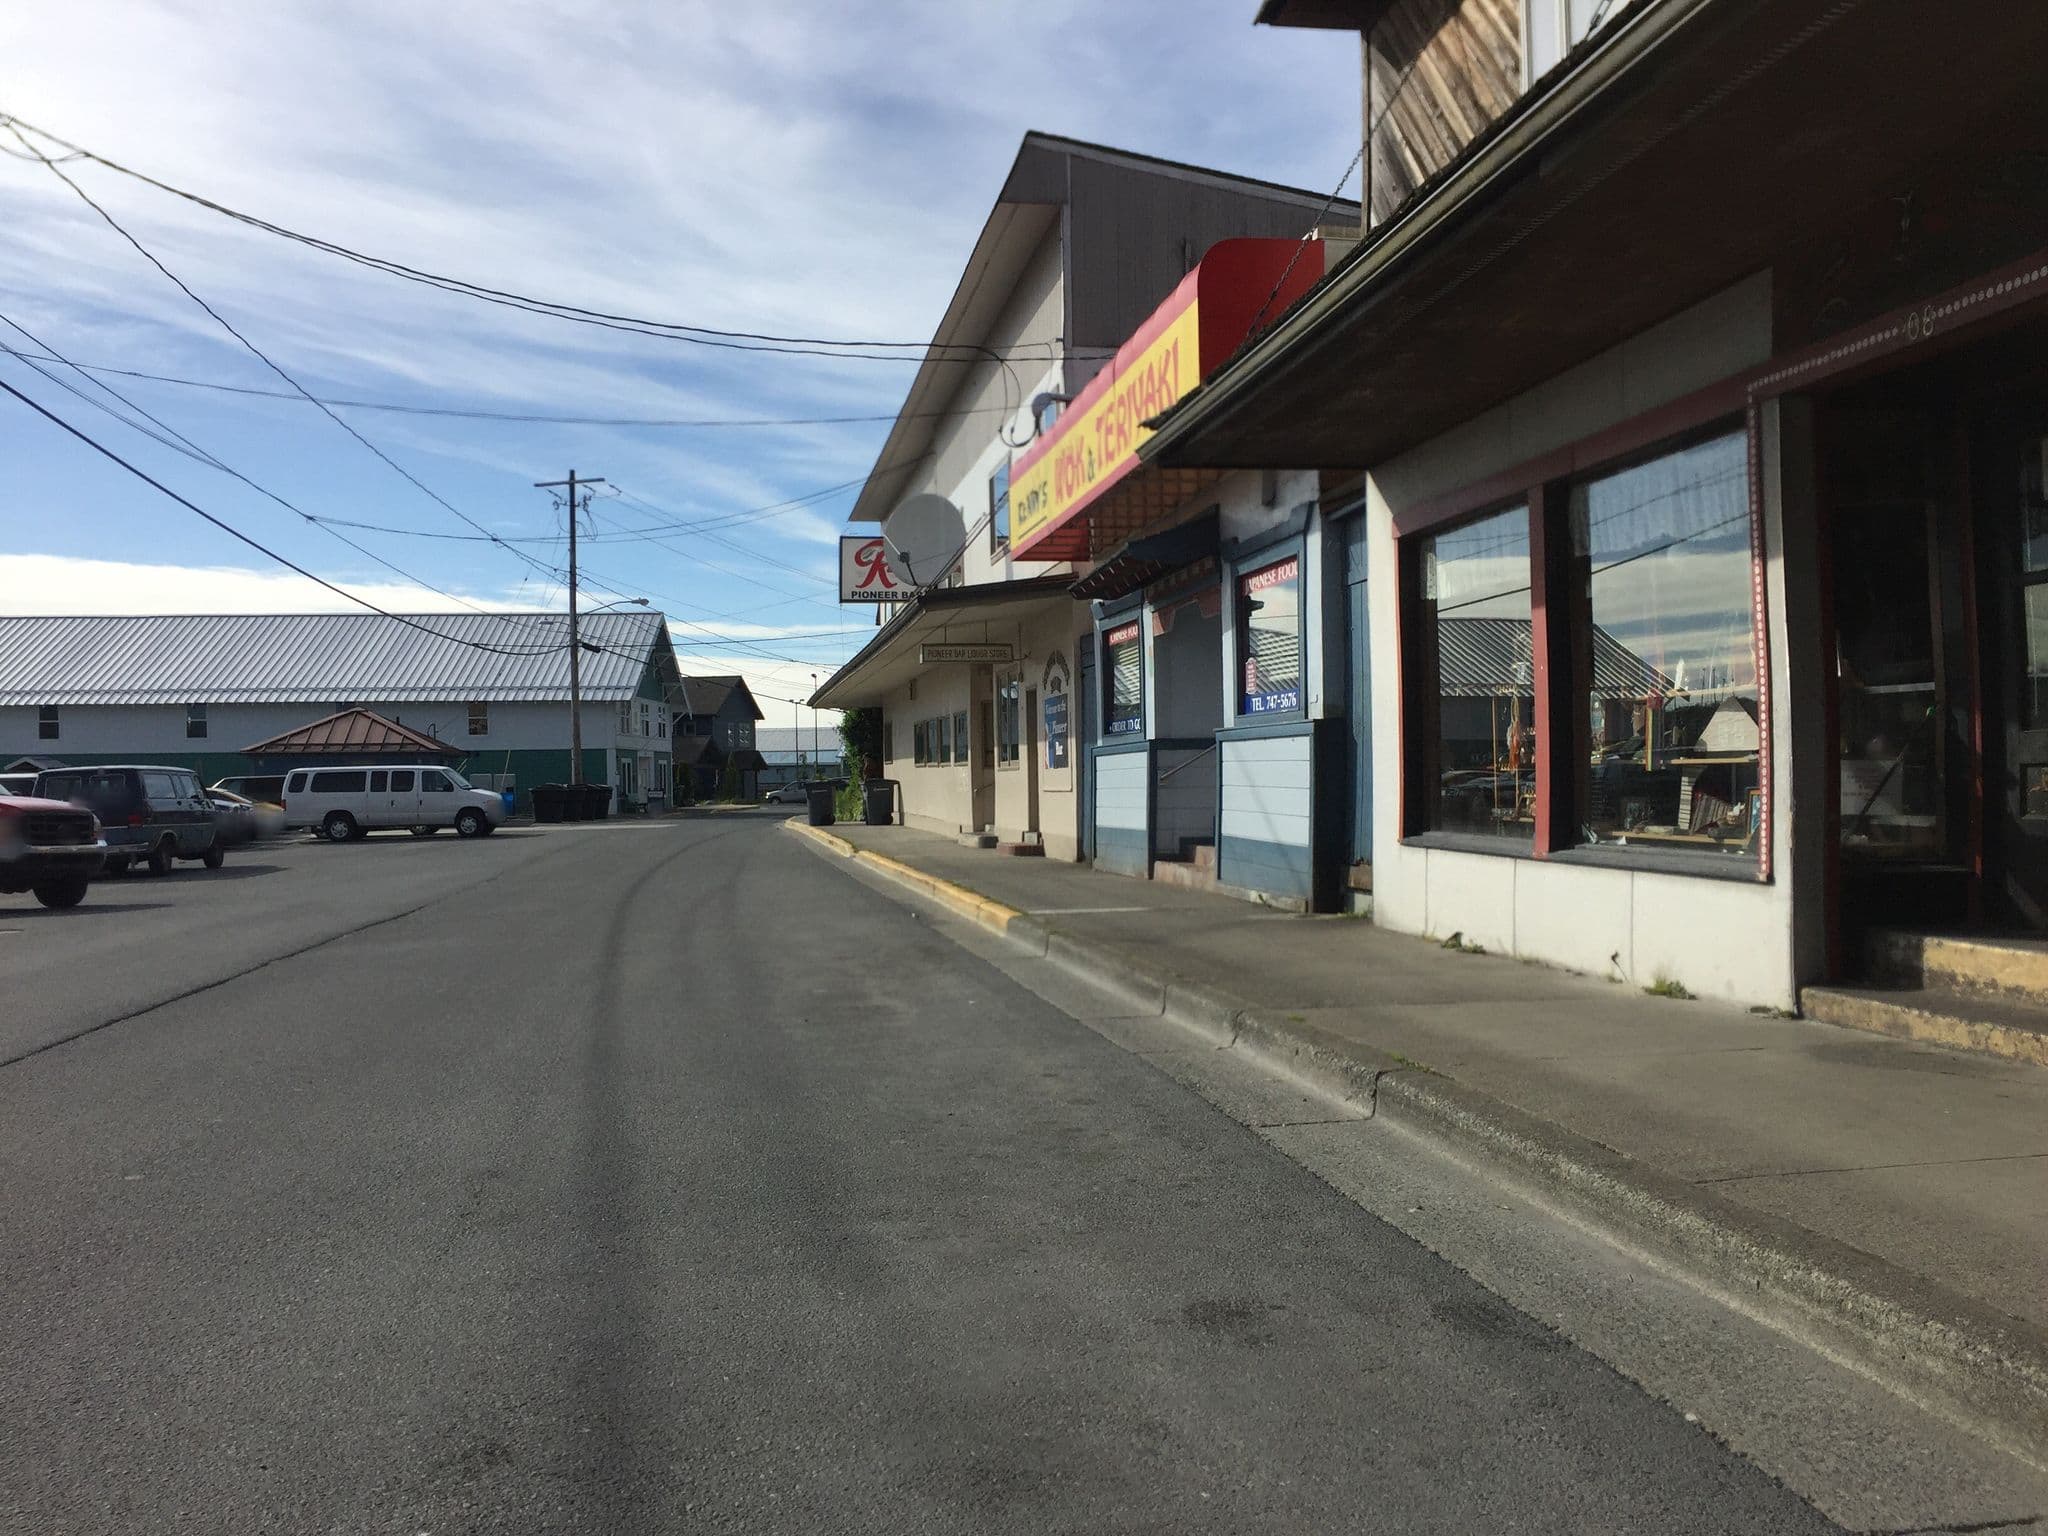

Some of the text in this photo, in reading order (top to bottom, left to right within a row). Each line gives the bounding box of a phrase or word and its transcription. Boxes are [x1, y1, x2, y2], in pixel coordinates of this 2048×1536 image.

[1054, 436, 1085, 503] WOK
[1095, 337, 1179, 469] TERIYAKI
[851, 591, 898, 599] PIONEER
[1266, 692, 1297, 709] 747-5676
